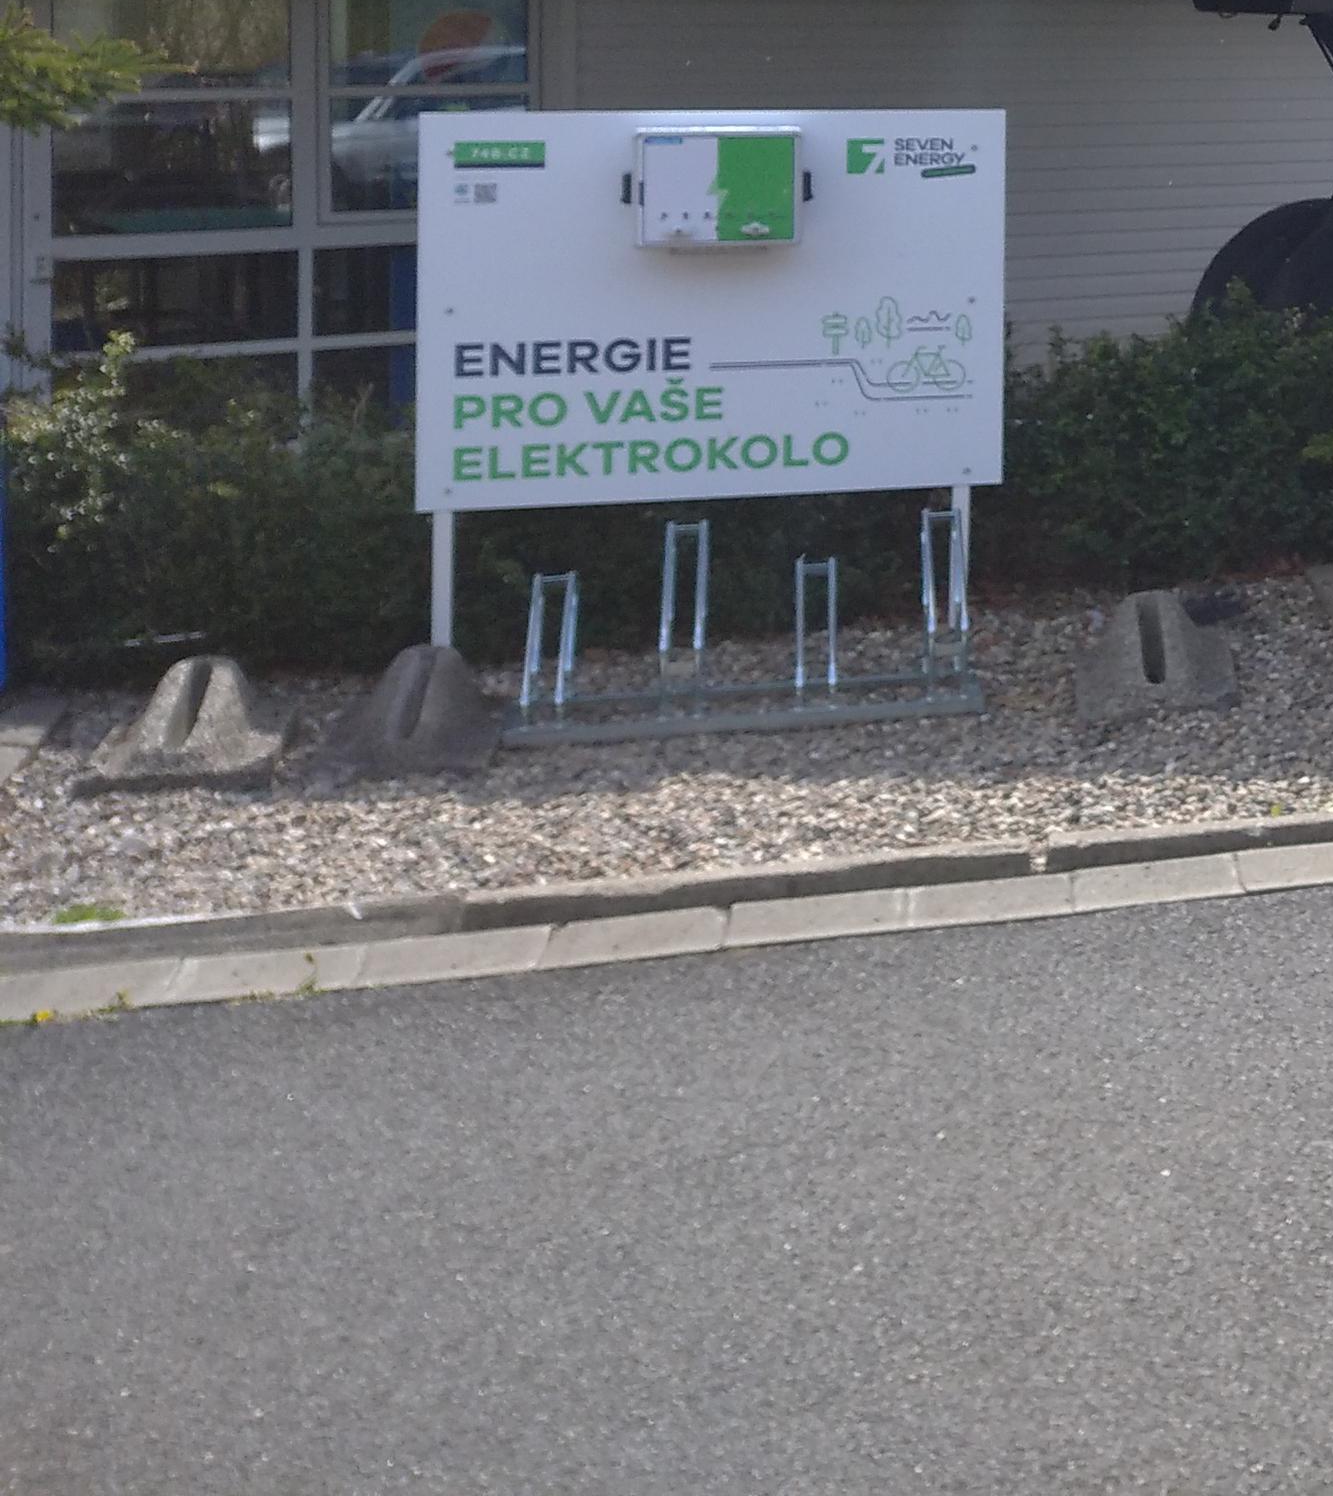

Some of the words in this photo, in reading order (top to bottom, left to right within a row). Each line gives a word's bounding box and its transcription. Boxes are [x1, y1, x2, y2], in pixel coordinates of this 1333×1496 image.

[894, 137, 953, 152] SEVEN
[894, 152, 966, 166] ENERGY
[454, 336, 691, 379] ENERGIE
[453, 390, 569, 430] PRO
[585, 378, 724, 425] VAŠE
[453, 431, 850, 483] ELEKTROKOLO
